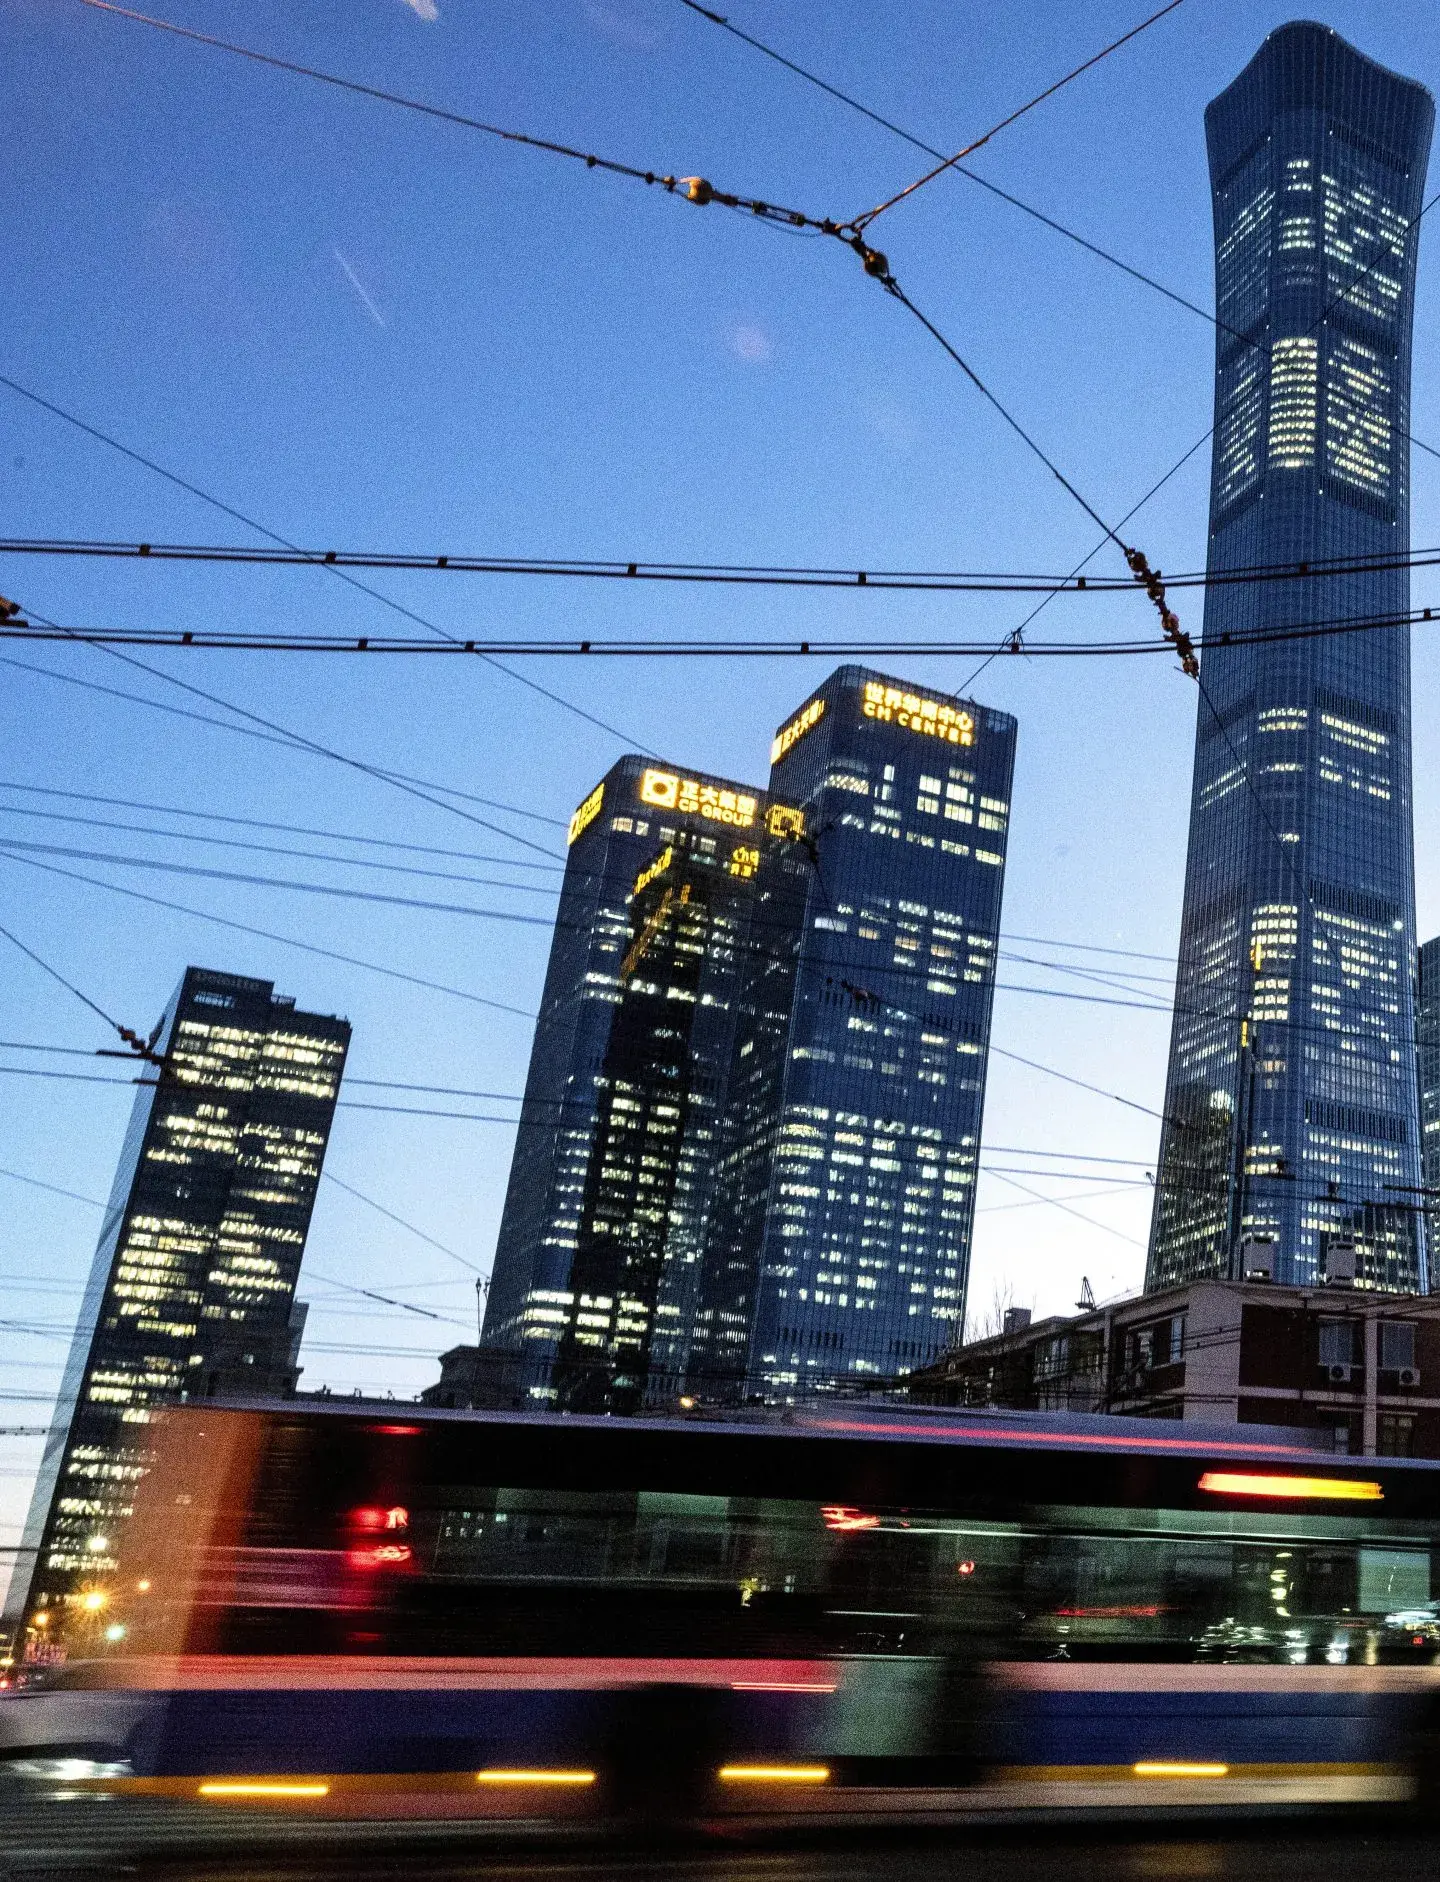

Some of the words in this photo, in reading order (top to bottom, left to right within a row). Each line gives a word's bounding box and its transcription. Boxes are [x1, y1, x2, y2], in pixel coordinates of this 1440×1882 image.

[897, 712, 972, 746] CENTER
[678, 797, 700, 813] CP
[700, 803, 754, 828] GROUP
[679, 779, 757, 817] 正大集团
